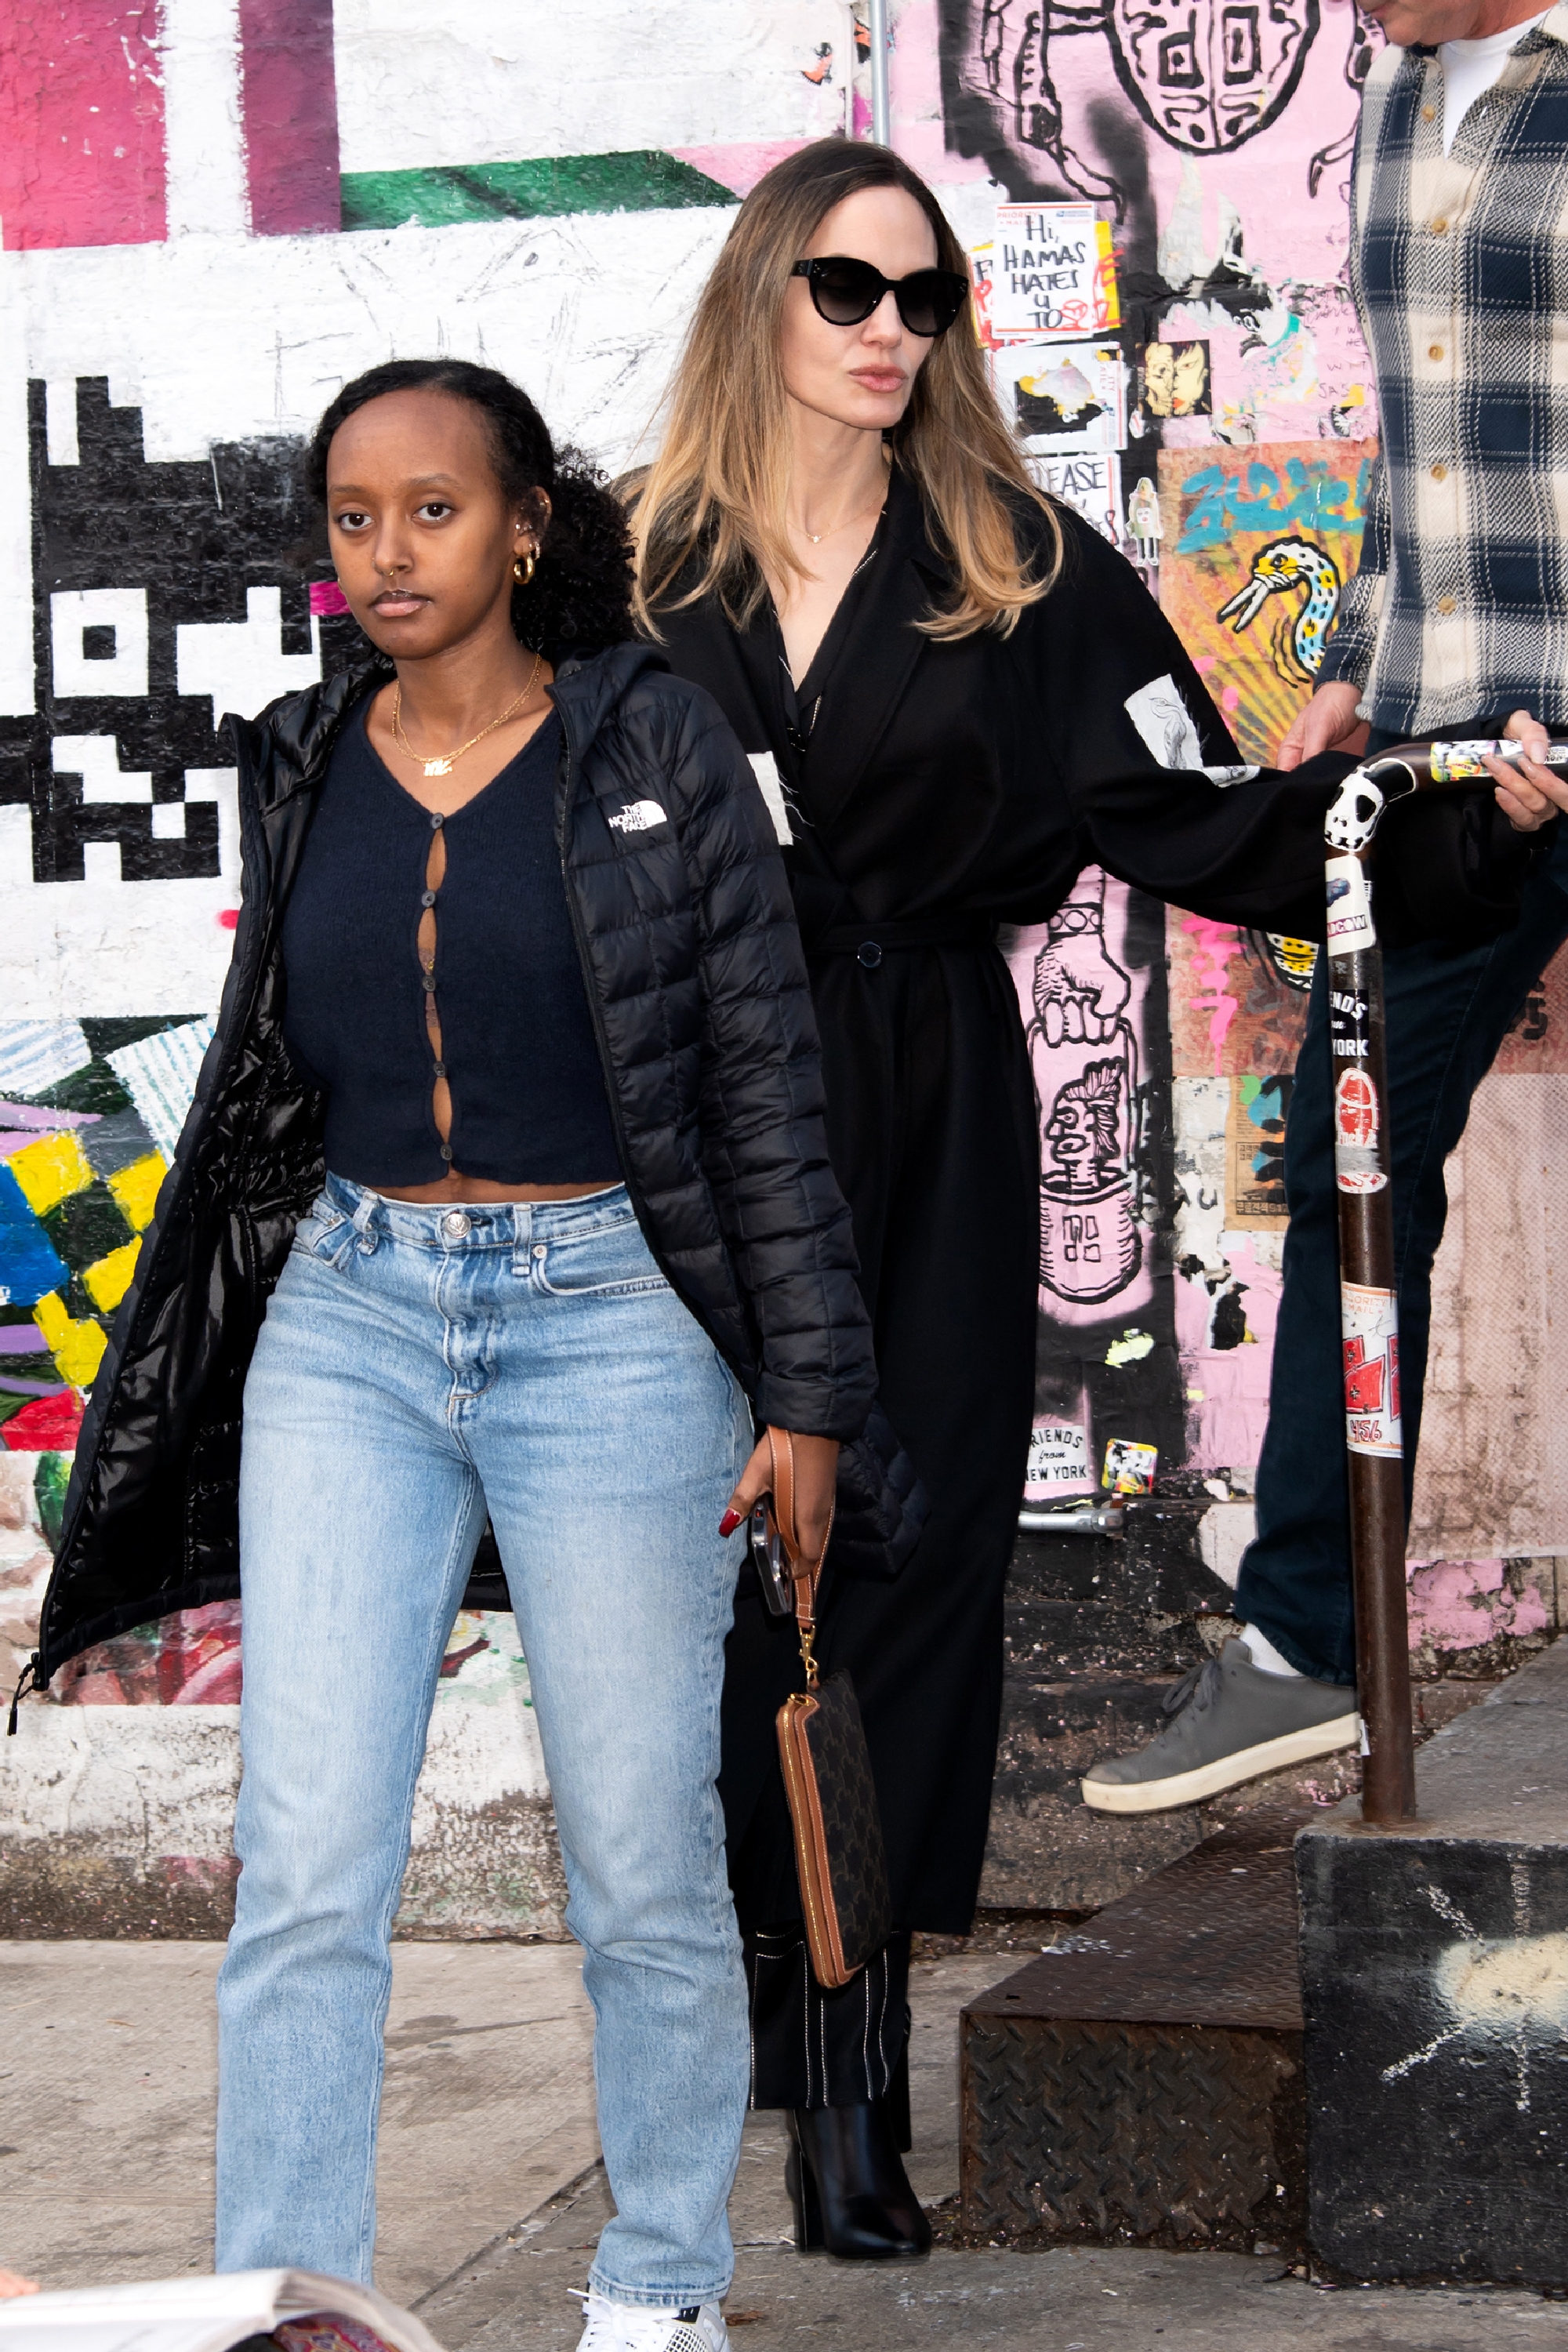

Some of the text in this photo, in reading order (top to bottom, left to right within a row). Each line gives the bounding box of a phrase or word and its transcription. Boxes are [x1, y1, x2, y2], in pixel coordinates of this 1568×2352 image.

[1025, 214, 1059, 243] Hi,
[1004, 241, 1086, 271] HAMAS
[1011, 270, 1079, 295] HATES
[620, 802, 641, 815] THE
[608, 812, 646, 829] NORTH
[622, 820, 648, 833] FACE
[1330, 991, 1368, 1020] NDS
[1349, 1304, 1374, 1314] MAIL
[1031, 1428, 1083, 1449] RIENDS
[1039, 1450, 1066, 1464] from
[1054, 1465, 1087, 1479] YORK
